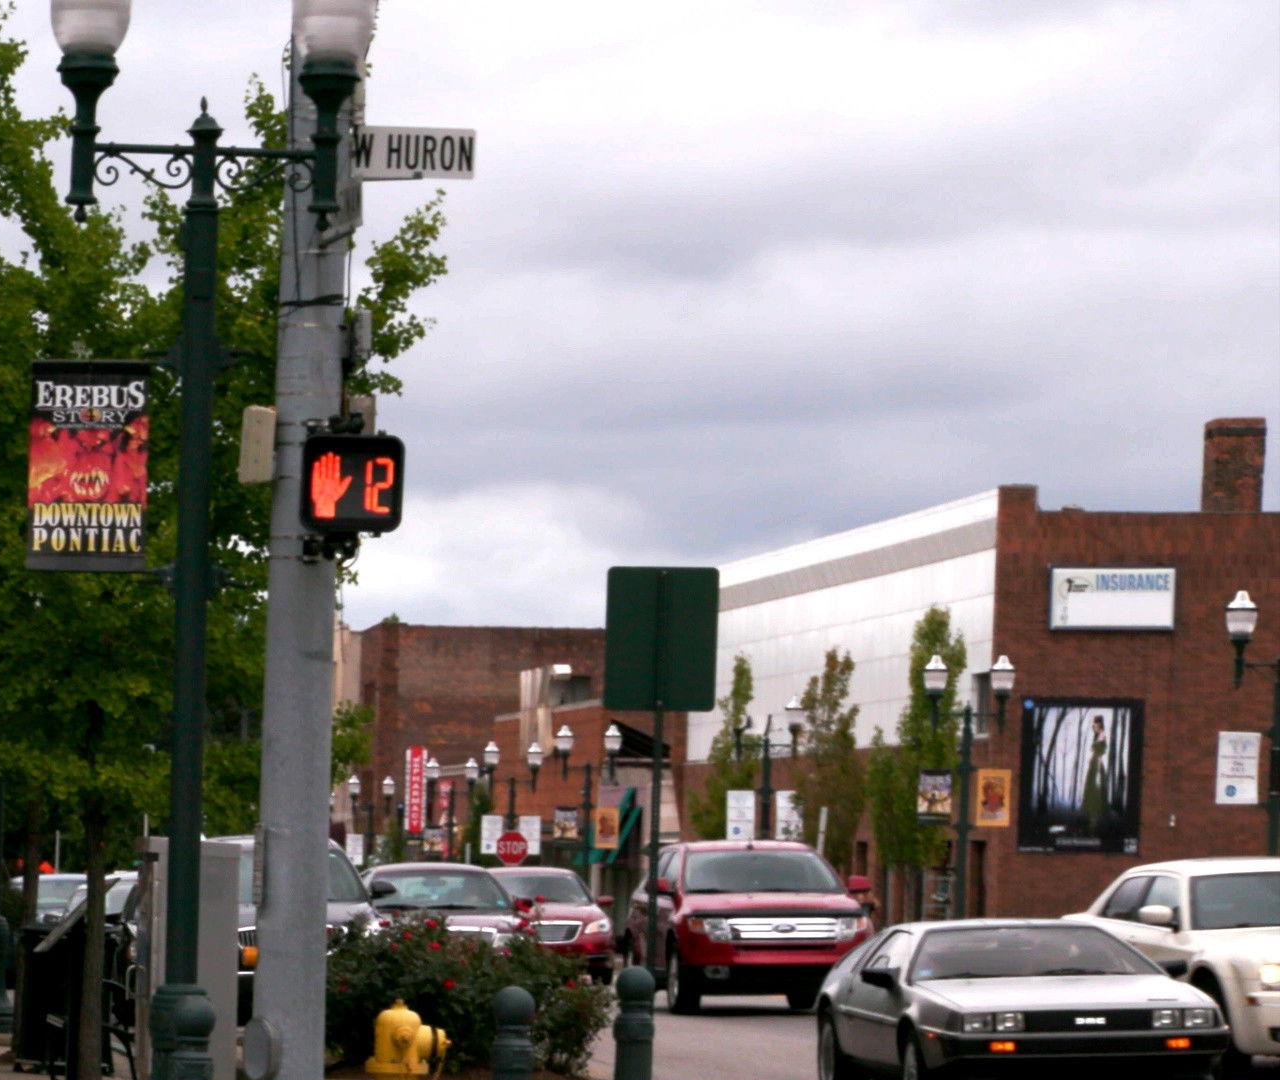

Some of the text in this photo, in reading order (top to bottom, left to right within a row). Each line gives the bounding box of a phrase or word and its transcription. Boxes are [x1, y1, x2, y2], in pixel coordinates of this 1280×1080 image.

[353, 133, 474, 171] W HURON
[36, 381, 145, 408] EREBUS
[364, 457, 394, 514] 12
[33, 503, 142, 527] DOWNTOWN
[33, 527, 142, 552] PONTIAC
[1096, 574, 1170, 592] INSURANCE
[498, 841, 527, 855] STOP
